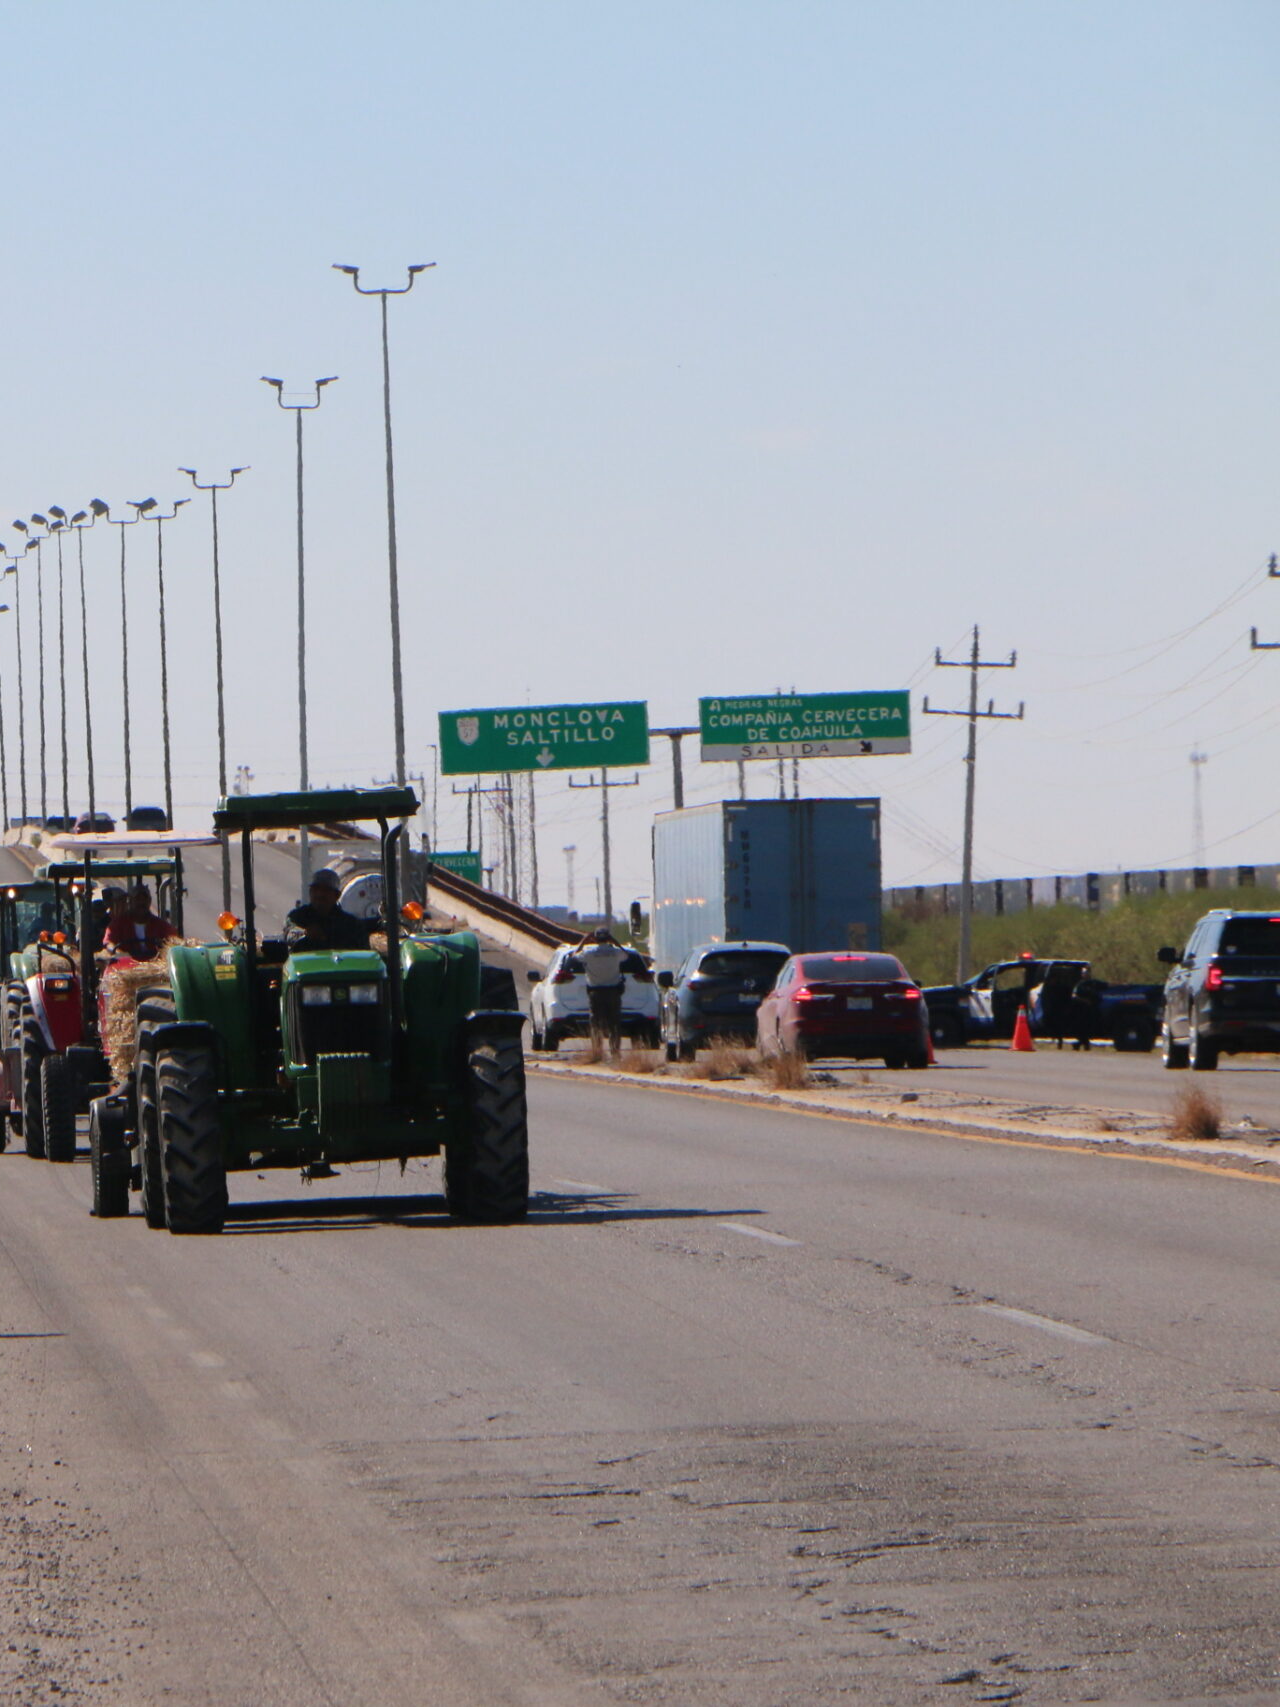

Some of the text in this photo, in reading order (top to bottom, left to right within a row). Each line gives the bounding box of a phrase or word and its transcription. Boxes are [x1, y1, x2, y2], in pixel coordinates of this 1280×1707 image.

[768, 698, 803, 708] NEGRAS
[494, 709, 624, 728] MONCLOVA
[802, 708, 903, 723] CERVECERA
[507, 727, 615, 745] SALTILLO
[748, 725, 862, 740] DE COAHUILA
[742, 743, 829, 758] SALIDA
